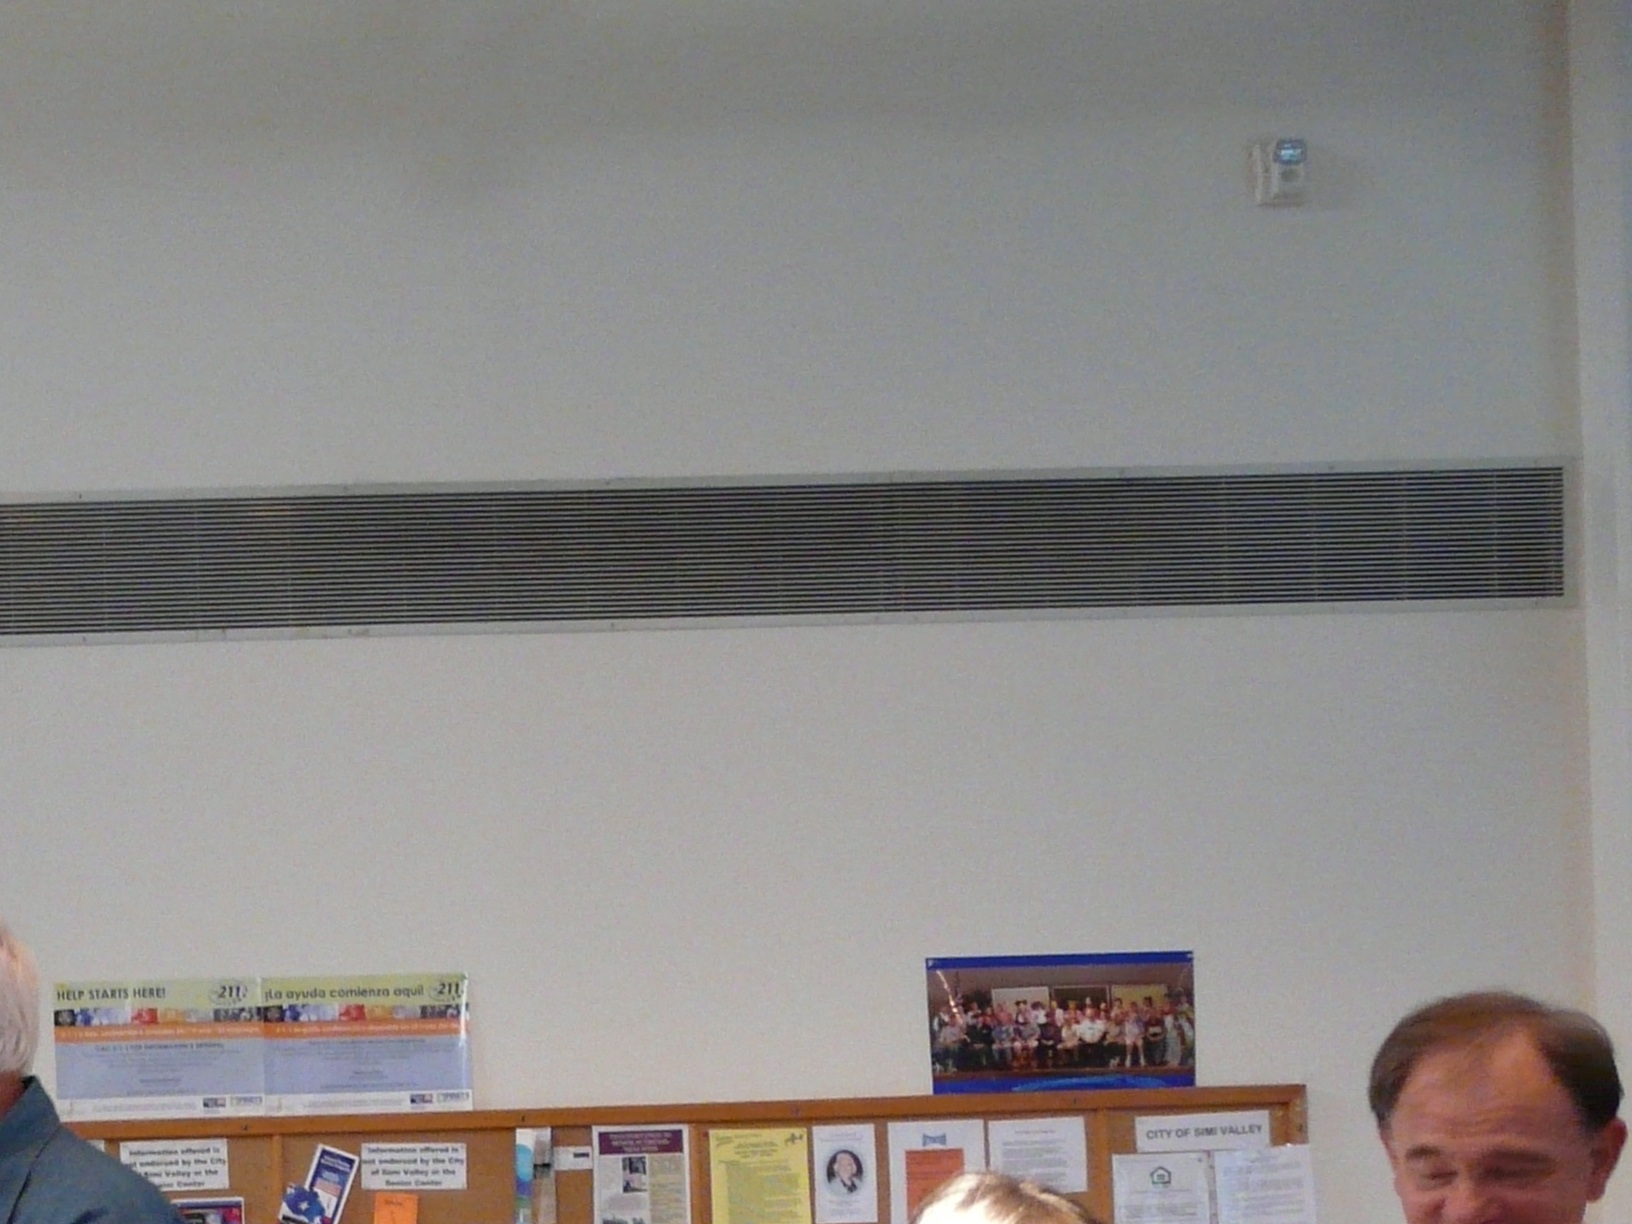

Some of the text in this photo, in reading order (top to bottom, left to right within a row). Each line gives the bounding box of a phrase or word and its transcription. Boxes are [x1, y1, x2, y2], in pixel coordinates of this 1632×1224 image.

[57, 986, 166, 1001] HELP STARTS HERE!
[286, 987, 326, 1001] ayuda
[329, 986, 390, 999] comienza
[1146, 1124, 1263, 1140] CITY OF SIMI VALLEY
